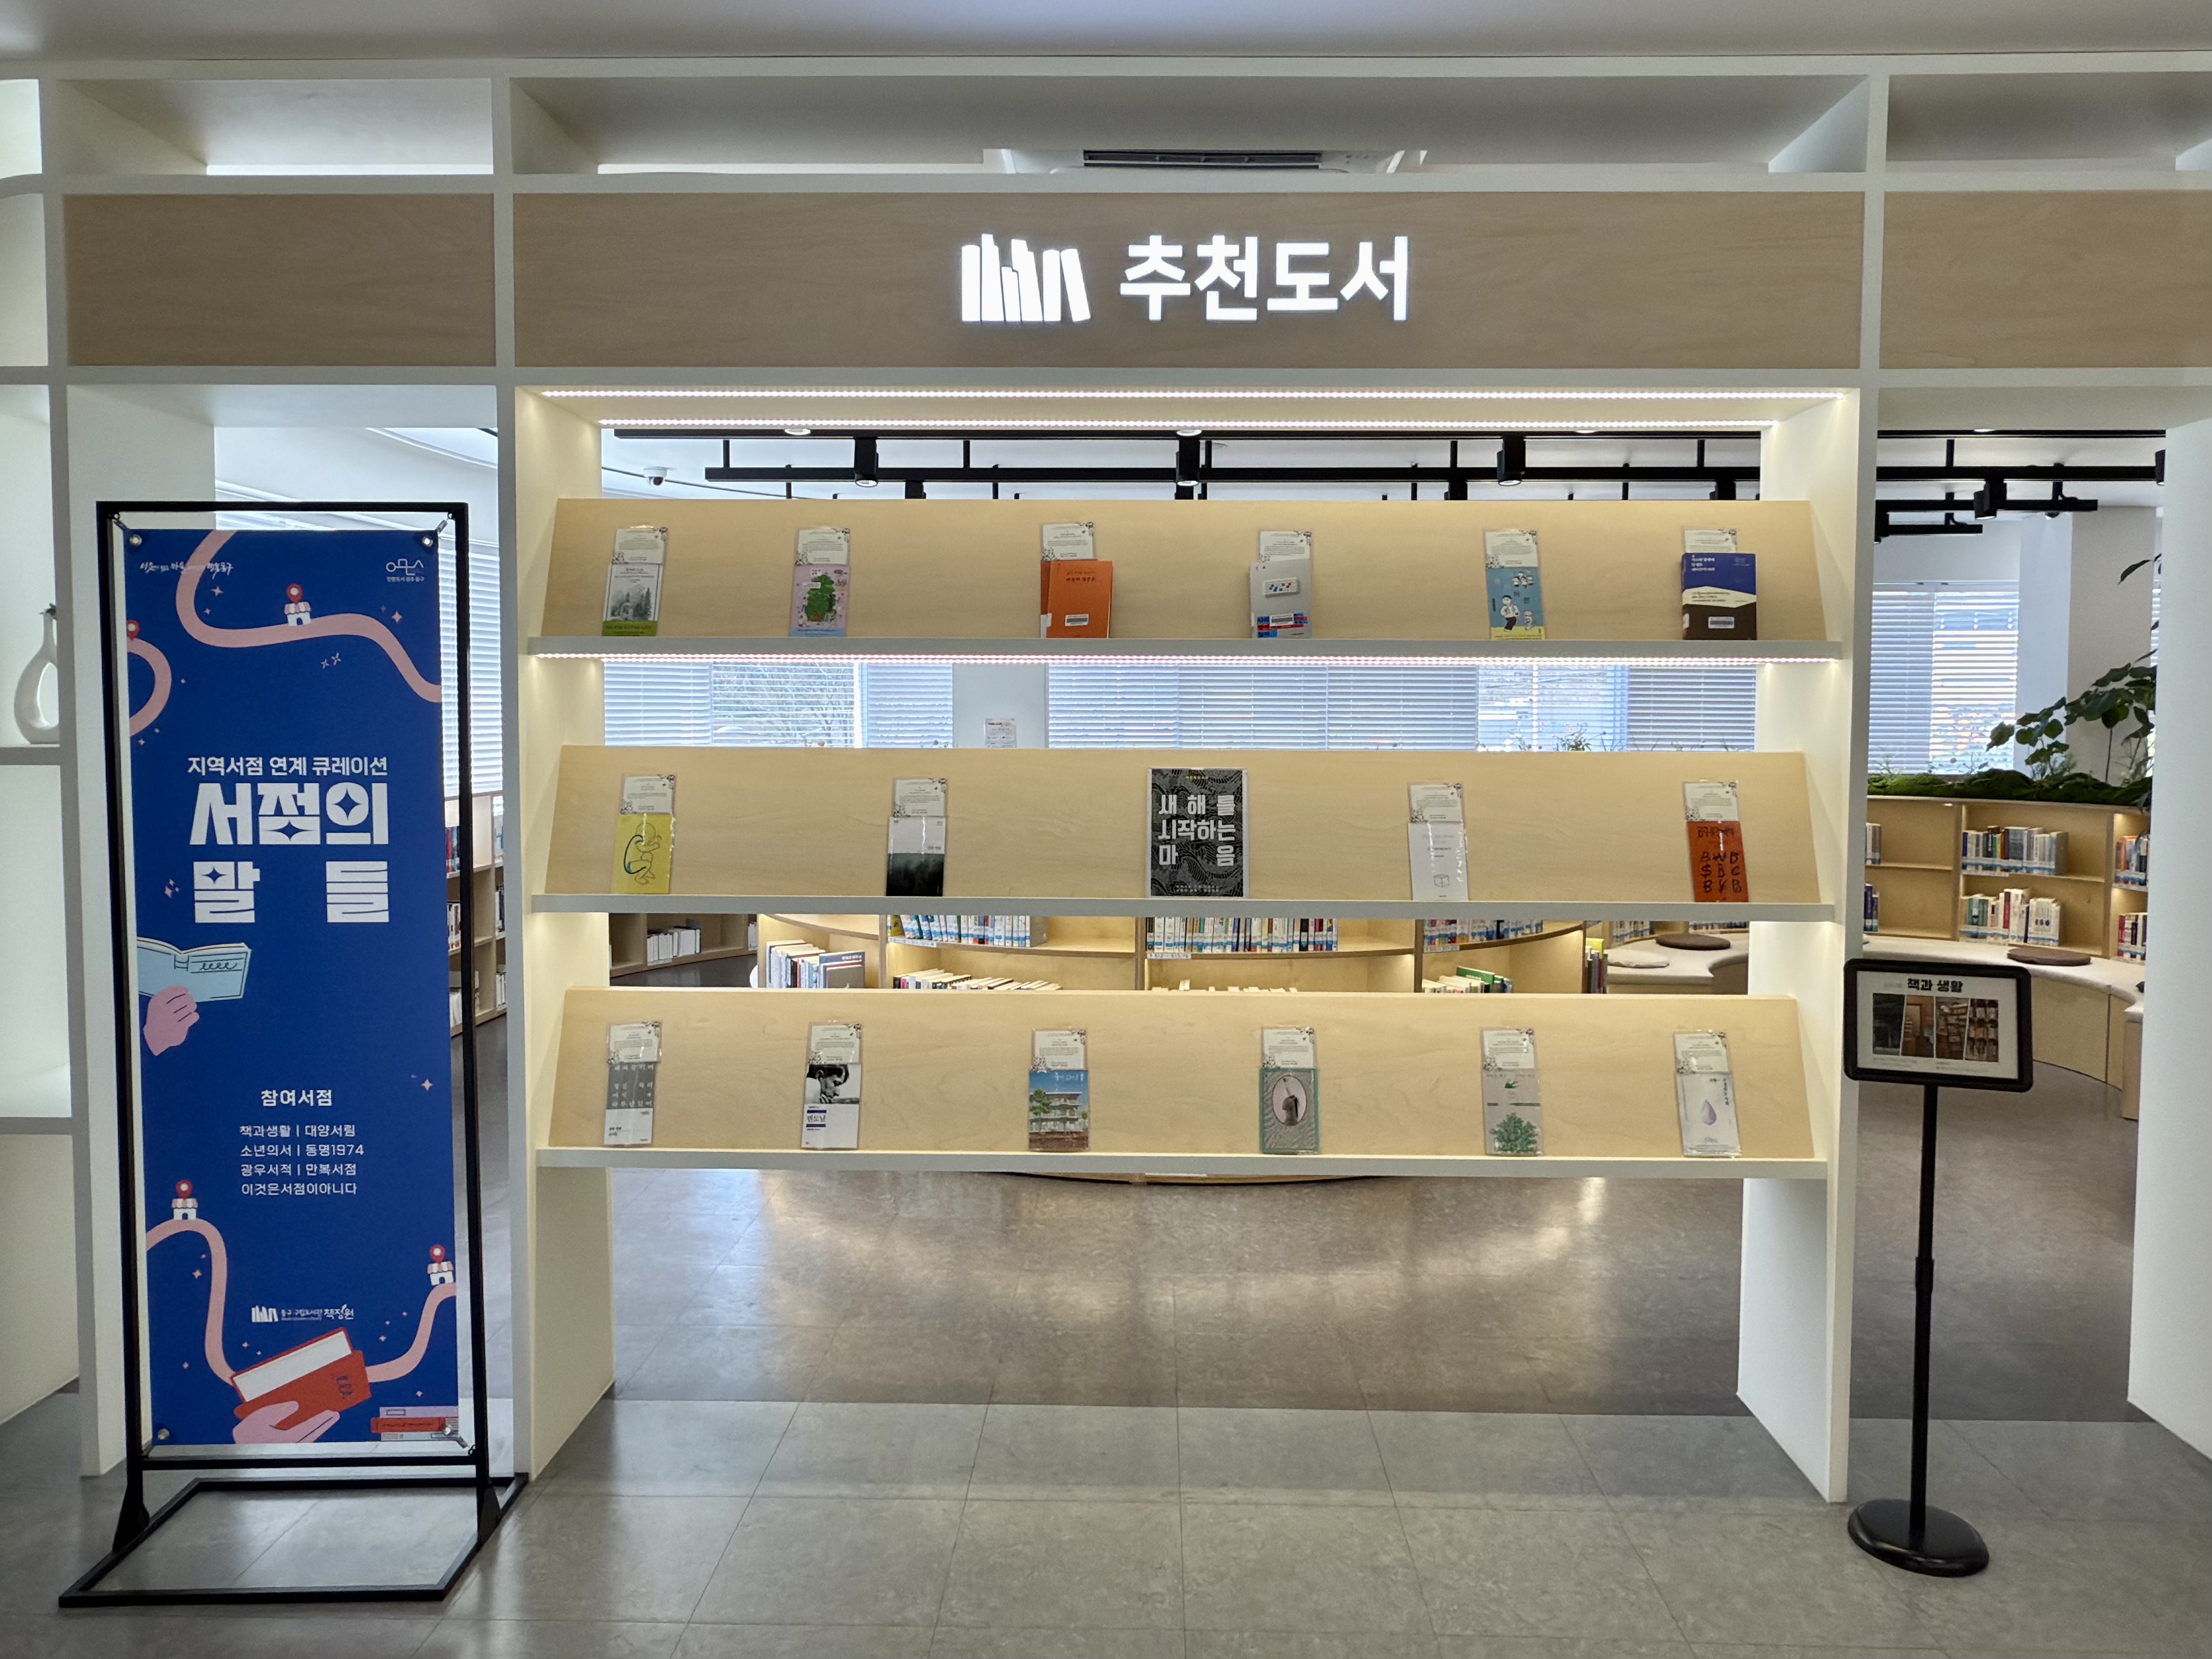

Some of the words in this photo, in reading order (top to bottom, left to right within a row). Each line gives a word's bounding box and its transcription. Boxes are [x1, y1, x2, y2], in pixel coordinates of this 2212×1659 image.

[1120, 235, 1408, 321] 추천도서
[187, 757, 263, 776] 지역서점
[269, 757, 307, 776] 연계
[312, 757, 388, 776] 큐레이션
[189, 782, 389, 845] 서점의
[1158, 819, 1236, 841] 시작하는
[1907, 978, 1933, 991] 책과
[1937, 980, 1963, 993] 생활
[261, 1089, 332, 1107] 참여서점
[239, 1125, 291, 1137] 책과생활
[305, 1125, 355, 1137] 대양서림
[240, 1144, 291, 1157] 소년의서
[306, 1144, 364, 1157] 동명1974
[241, 1164, 291, 1177] 광우서적
[306, 1163, 356, 1176] 만복서점
[241, 1183, 357, 1196] 이것은서점이아니다
[324, 1304, 354, 1320] 책정원
